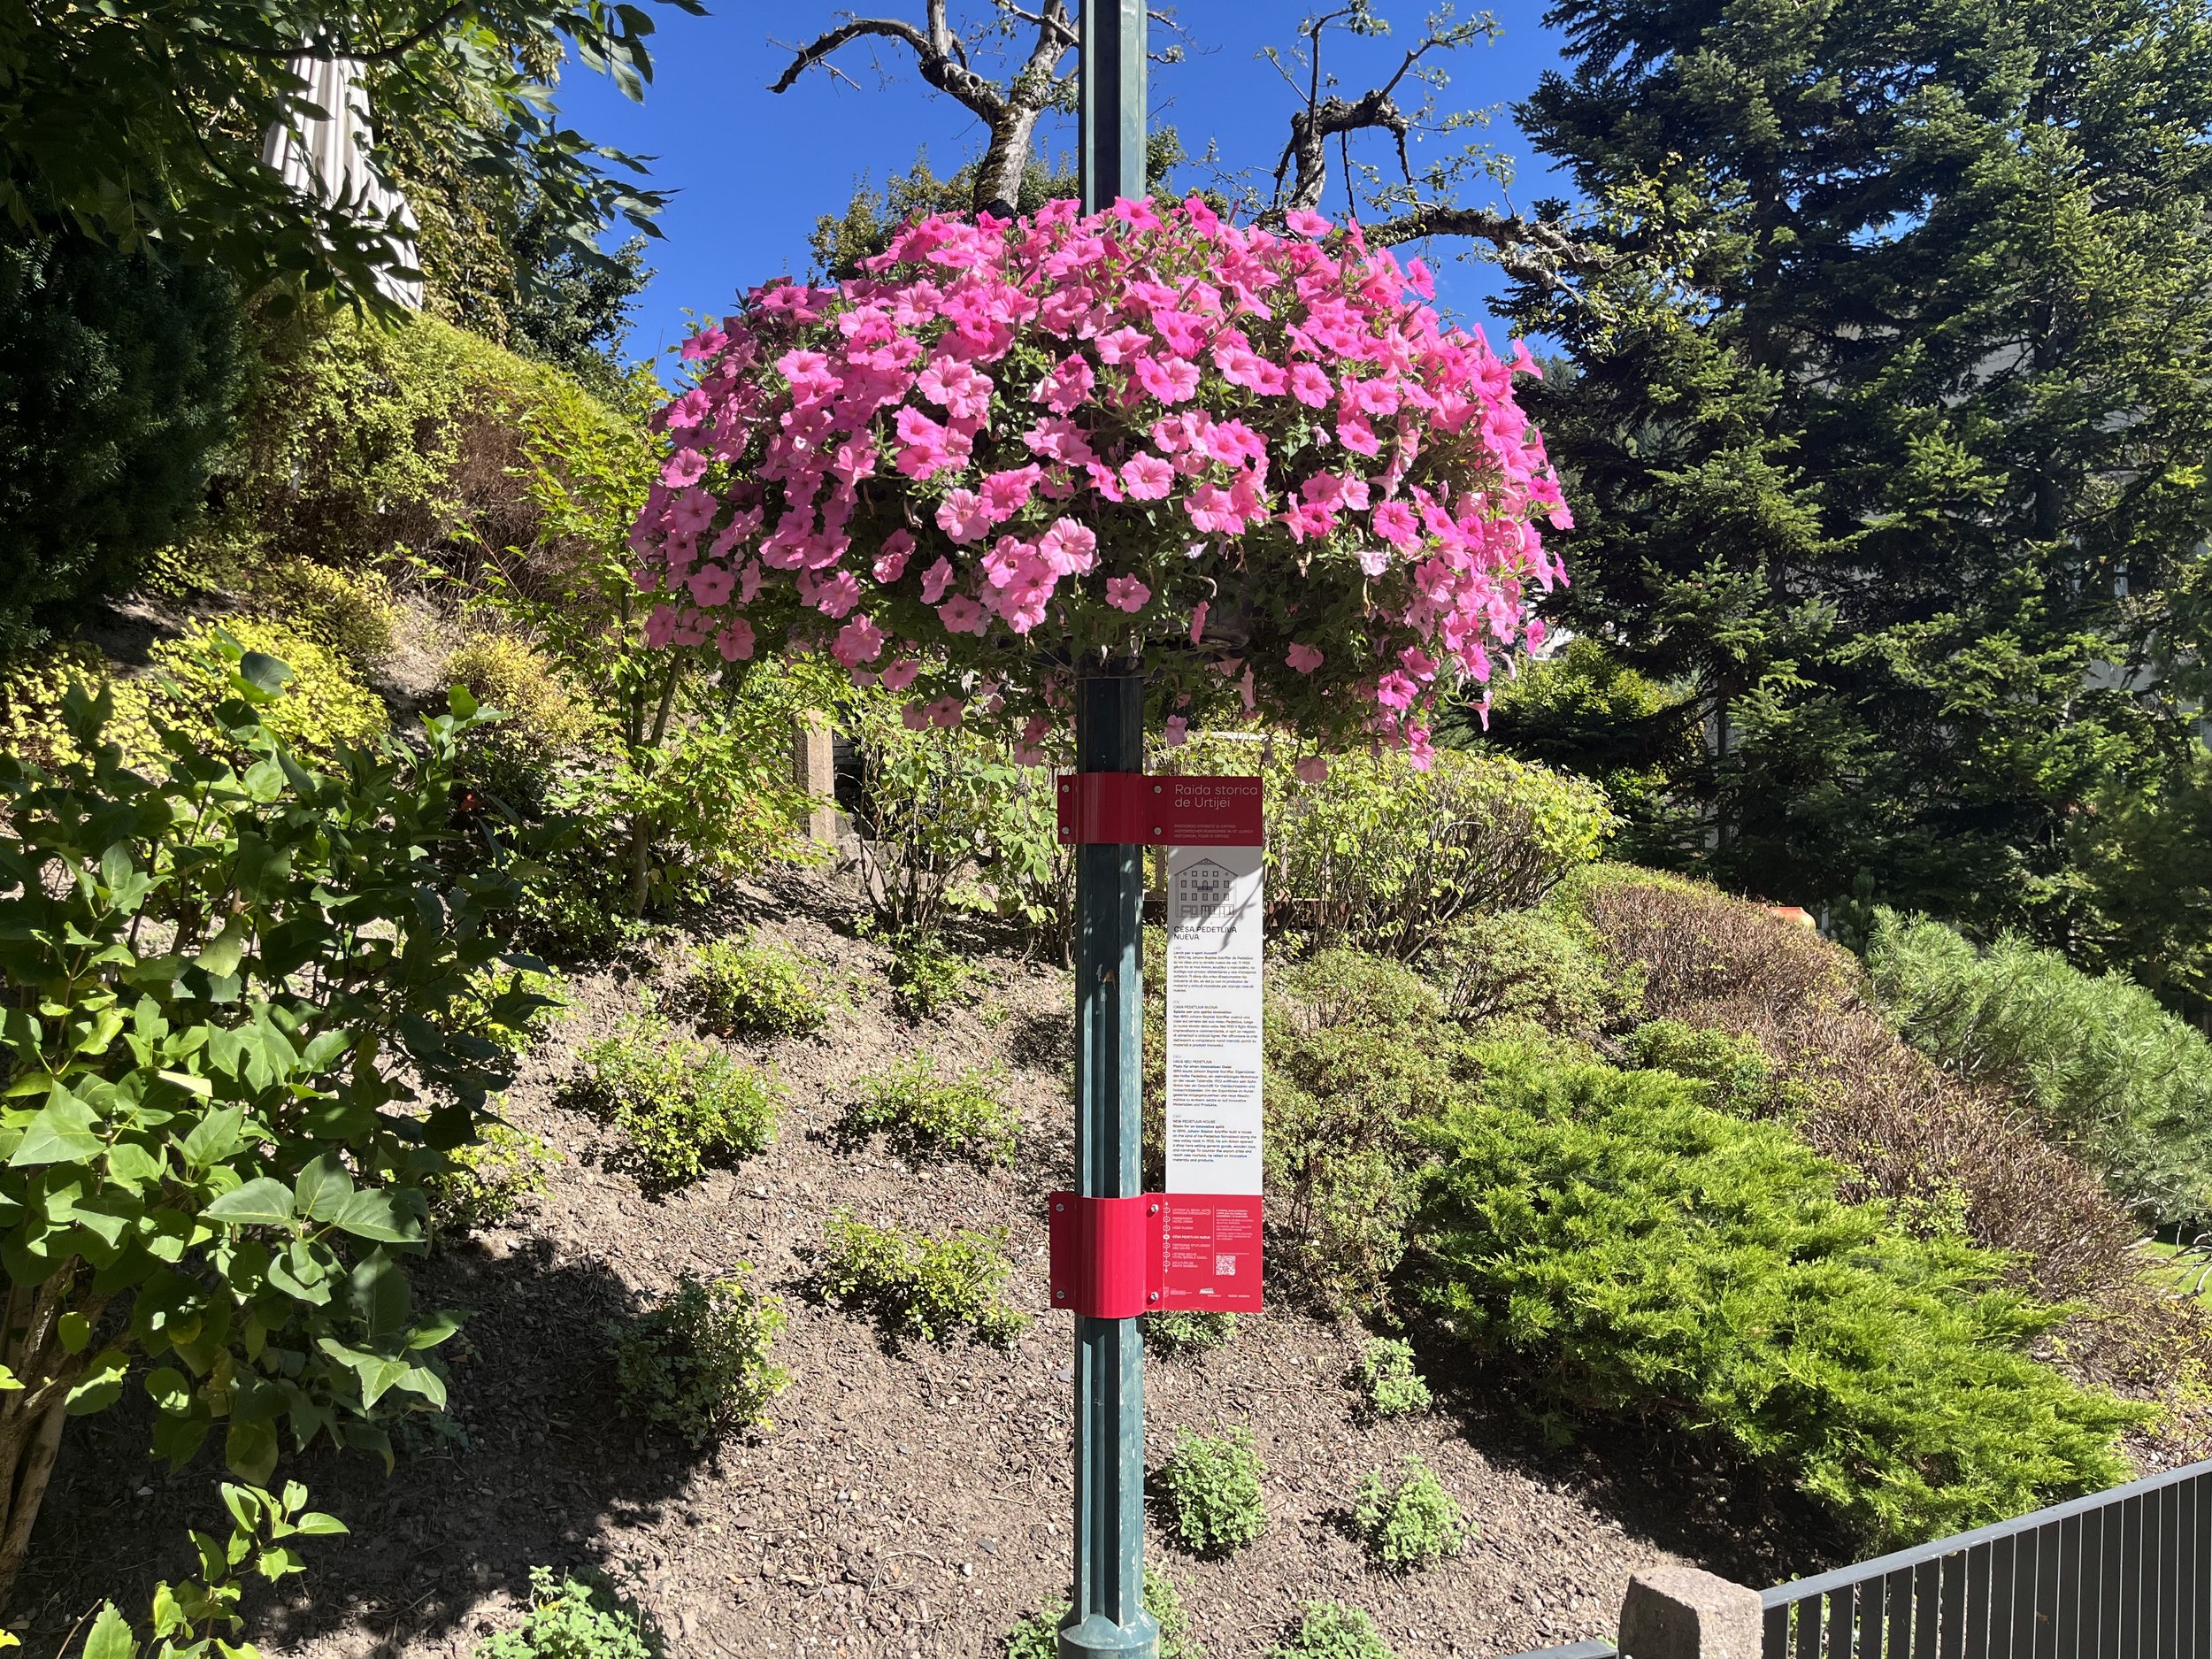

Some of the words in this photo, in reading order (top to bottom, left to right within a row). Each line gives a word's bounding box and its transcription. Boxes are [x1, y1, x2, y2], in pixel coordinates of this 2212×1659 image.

[1175, 784, 1210, 795] Raida
[1215, 784, 1258, 795] storica
[1175, 797, 1190, 808] de
[1194, 797, 1231, 810] Urtijëi
